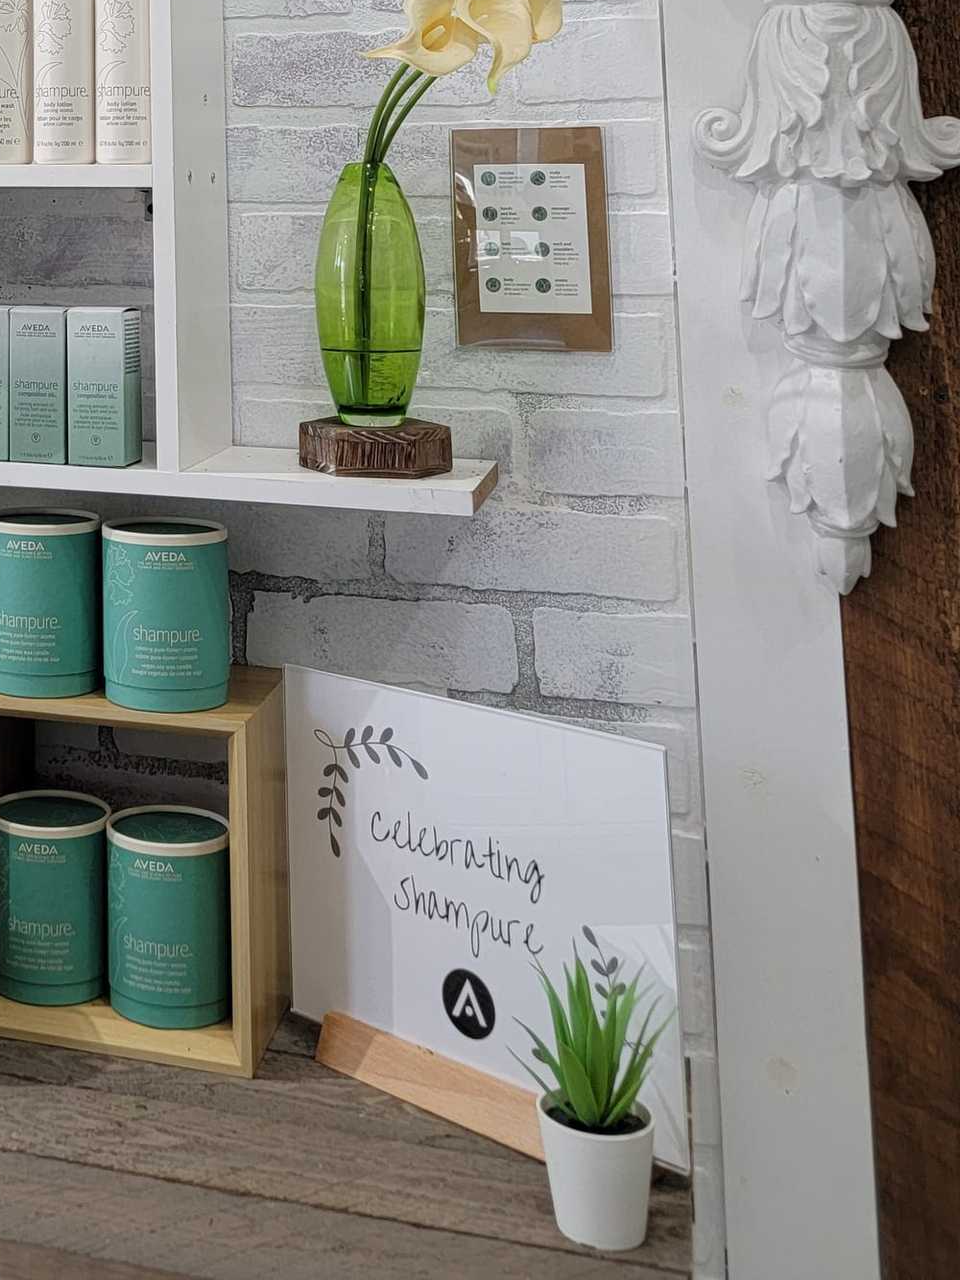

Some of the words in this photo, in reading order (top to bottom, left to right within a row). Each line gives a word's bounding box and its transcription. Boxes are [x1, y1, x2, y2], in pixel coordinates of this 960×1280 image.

[21, 323, 50, 332] AVEDA
[79, 324, 109, 332] AVEDA
[14, 378, 59, 391] shampure
[72, 380, 119, 393] shampure
[6, 540, 45, 552] AVEDA
[144, 551, 186, 563] AVEDA
[133, 623, 202, 648] shampure
[18, 842, 58, 856] AVEDA
[133, 858, 175, 873] AVEDA
[8, 915, 76, 941] shampure
[123, 931, 193, 961] shampure
